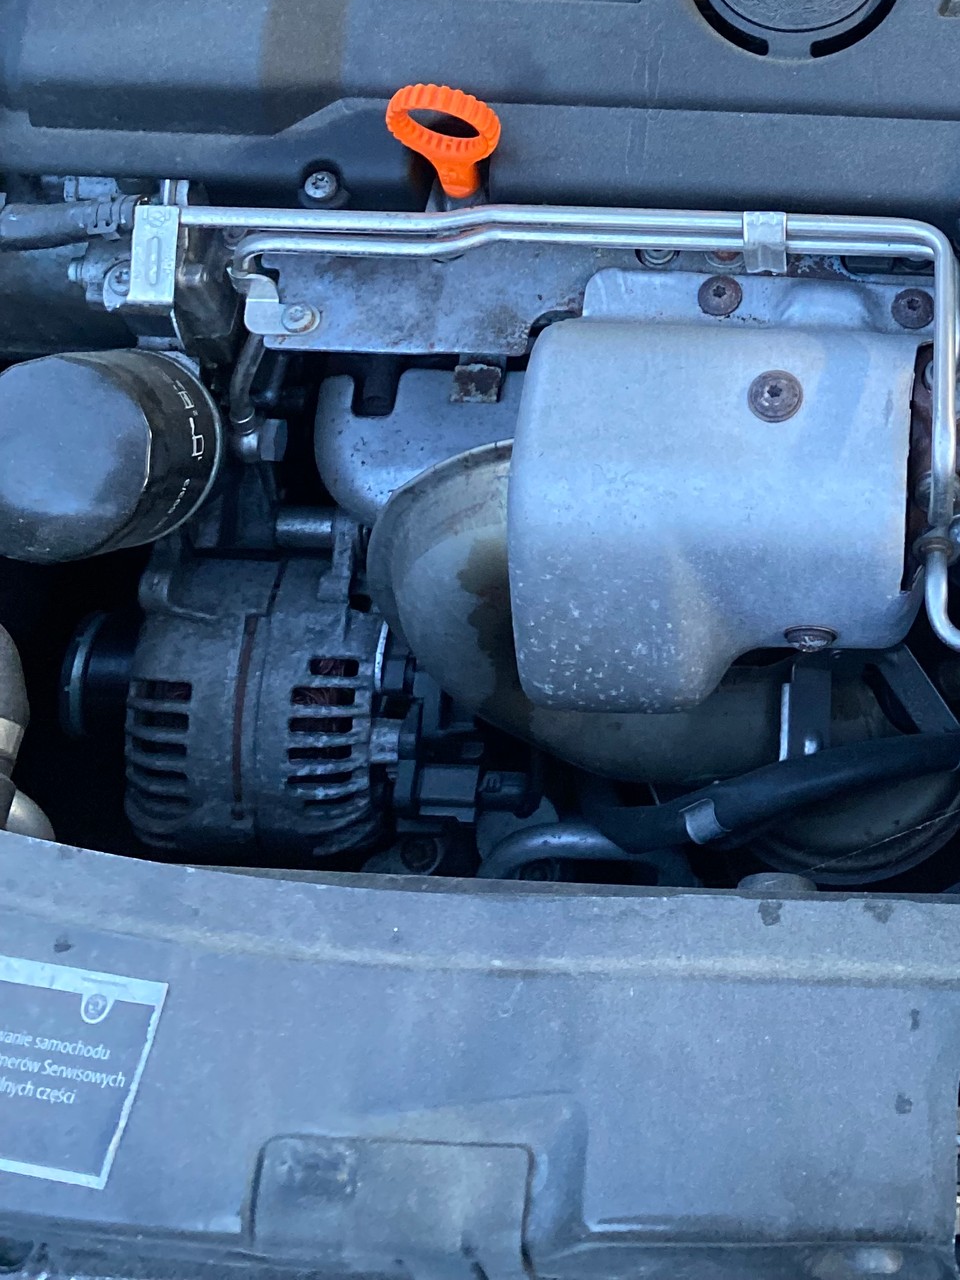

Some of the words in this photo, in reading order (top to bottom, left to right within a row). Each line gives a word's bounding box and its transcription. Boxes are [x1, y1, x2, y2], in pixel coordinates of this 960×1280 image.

[34, 1036, 111, 1060] samochodu
[0, 1052, 41, 1073] nerów
[41, 1059, 126, 1089] Serwisowych
[0, 1076, 34, 1098] lnych
[36, 1086, 77, 1104] części
